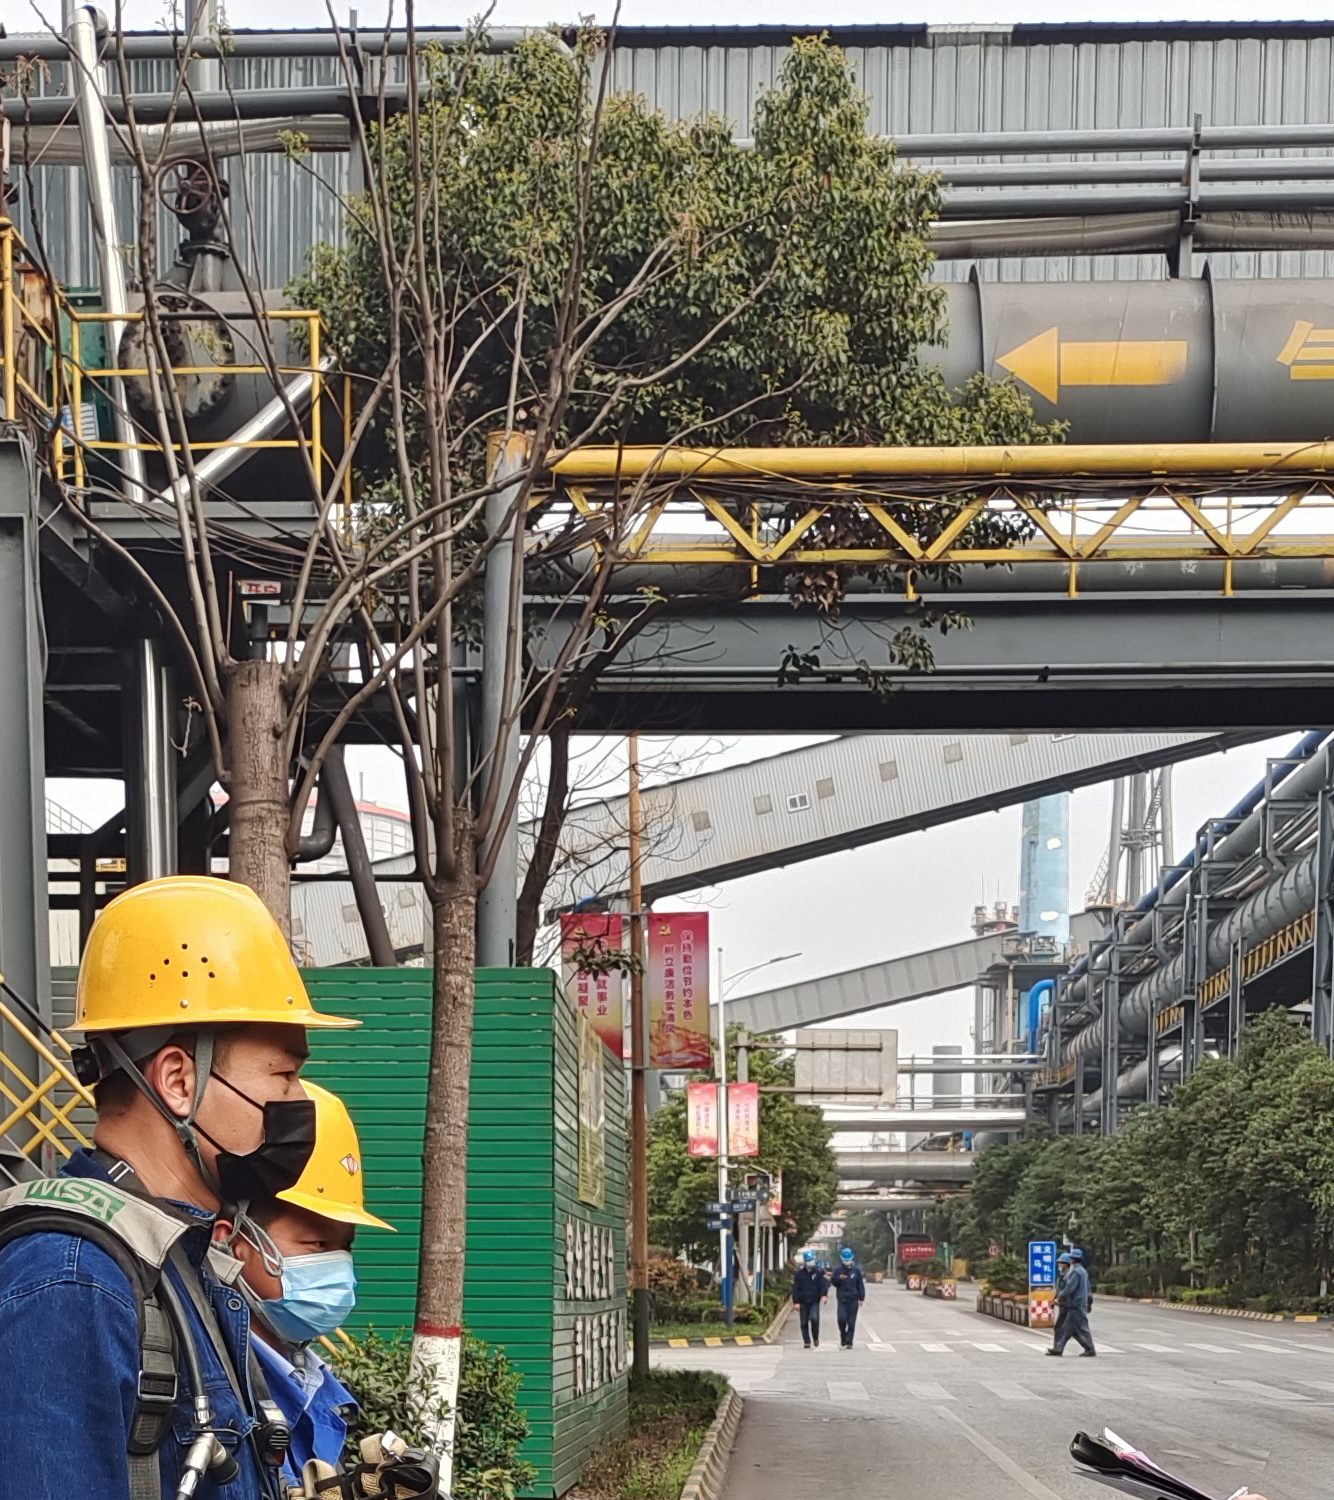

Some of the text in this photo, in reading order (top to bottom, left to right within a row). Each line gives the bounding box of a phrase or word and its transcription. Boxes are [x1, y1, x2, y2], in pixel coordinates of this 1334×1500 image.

[664, 945, 675, 1033] 树立廉洁务实清风
[681, 930, 693, 1020] 保持勤俭节约本色
[30, 1179, 112, 1219] MSA
